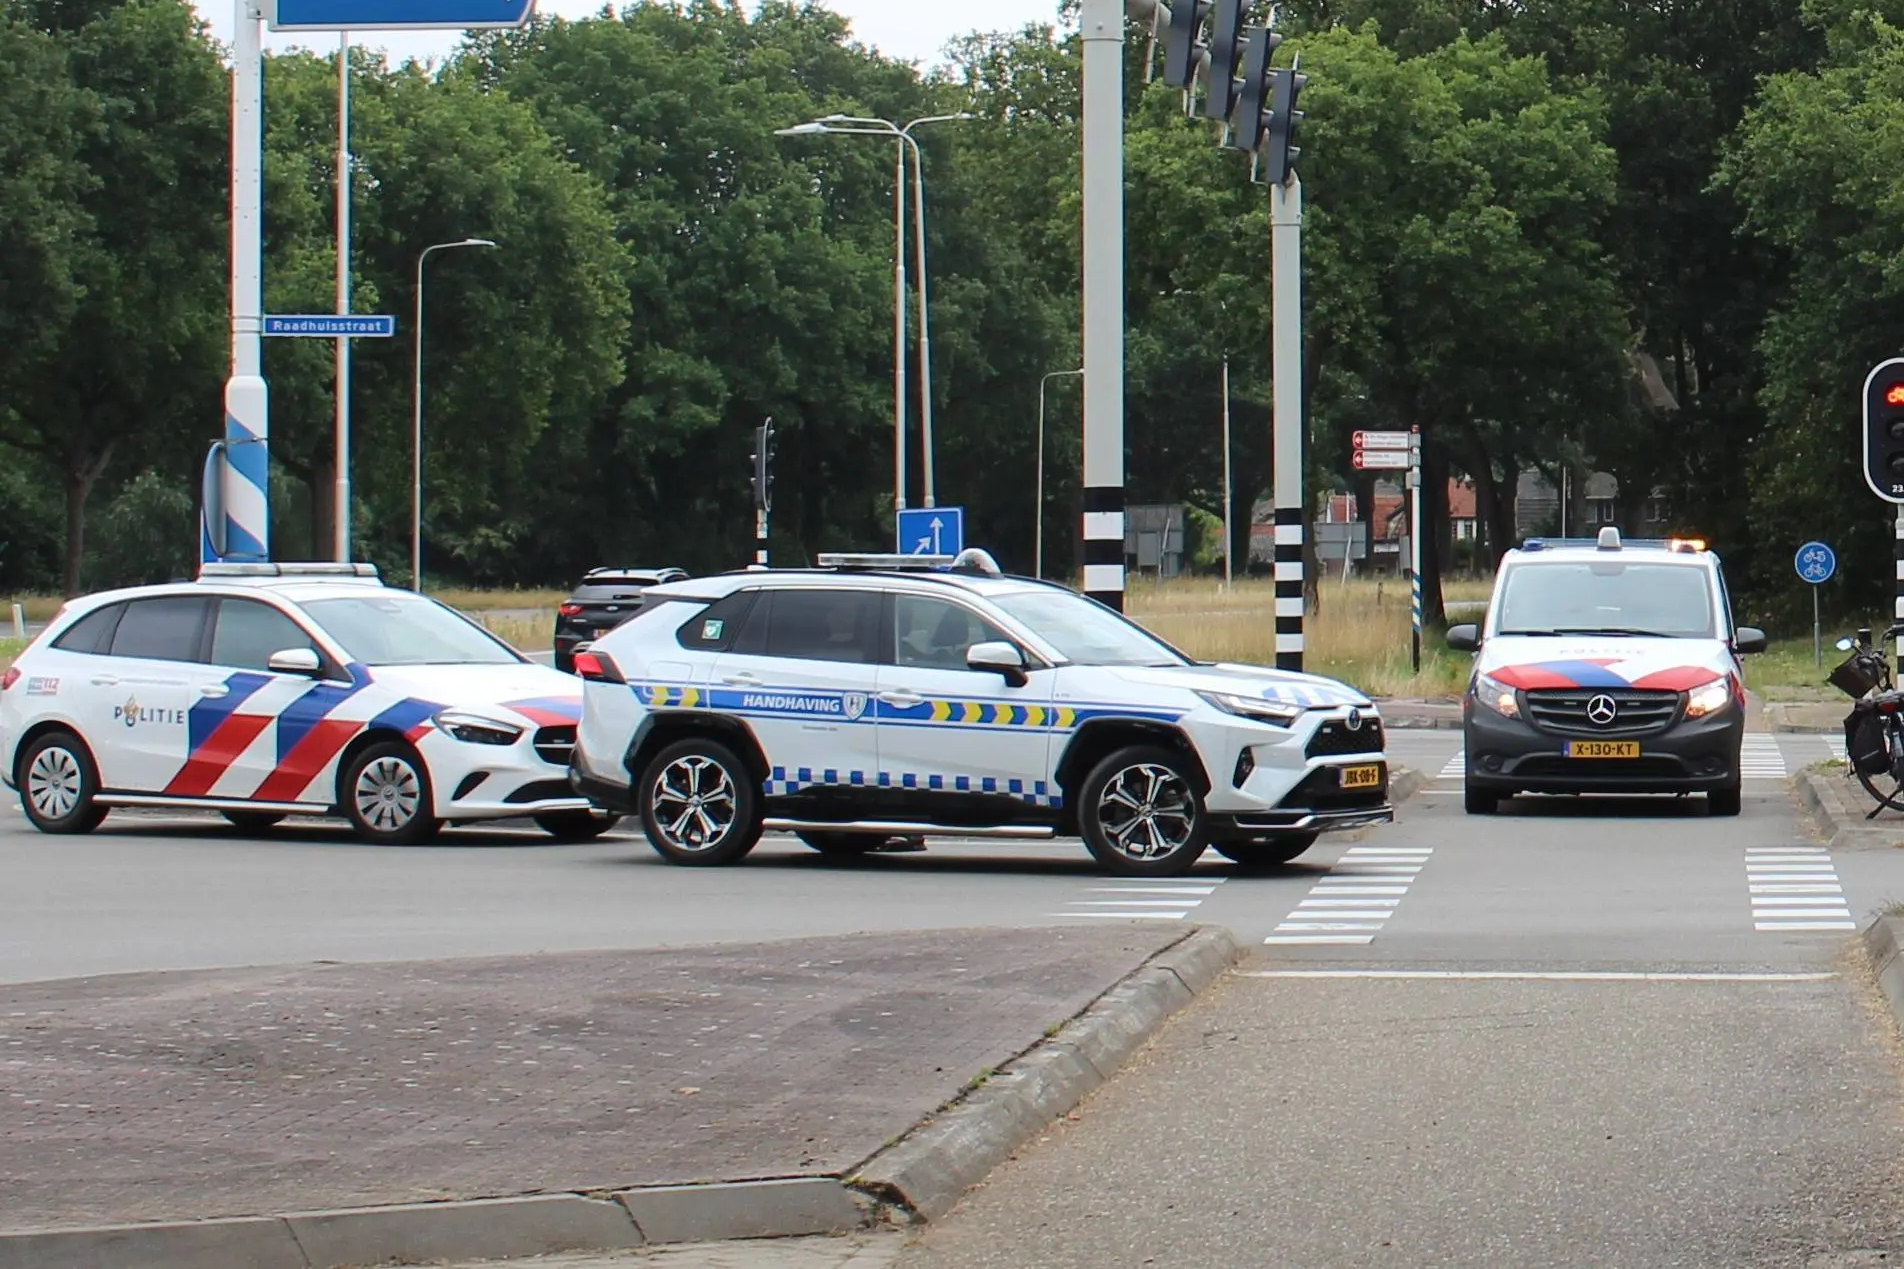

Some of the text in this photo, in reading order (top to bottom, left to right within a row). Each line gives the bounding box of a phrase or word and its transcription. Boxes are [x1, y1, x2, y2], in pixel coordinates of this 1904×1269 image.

[273, 321, 382, 331] Raadhuisstraat
[743, 693, 840, 712] HANDHAVING
[114, 703, 184, 727] POLITIE
[1576, 744, 1633, 755] X-130-KT
